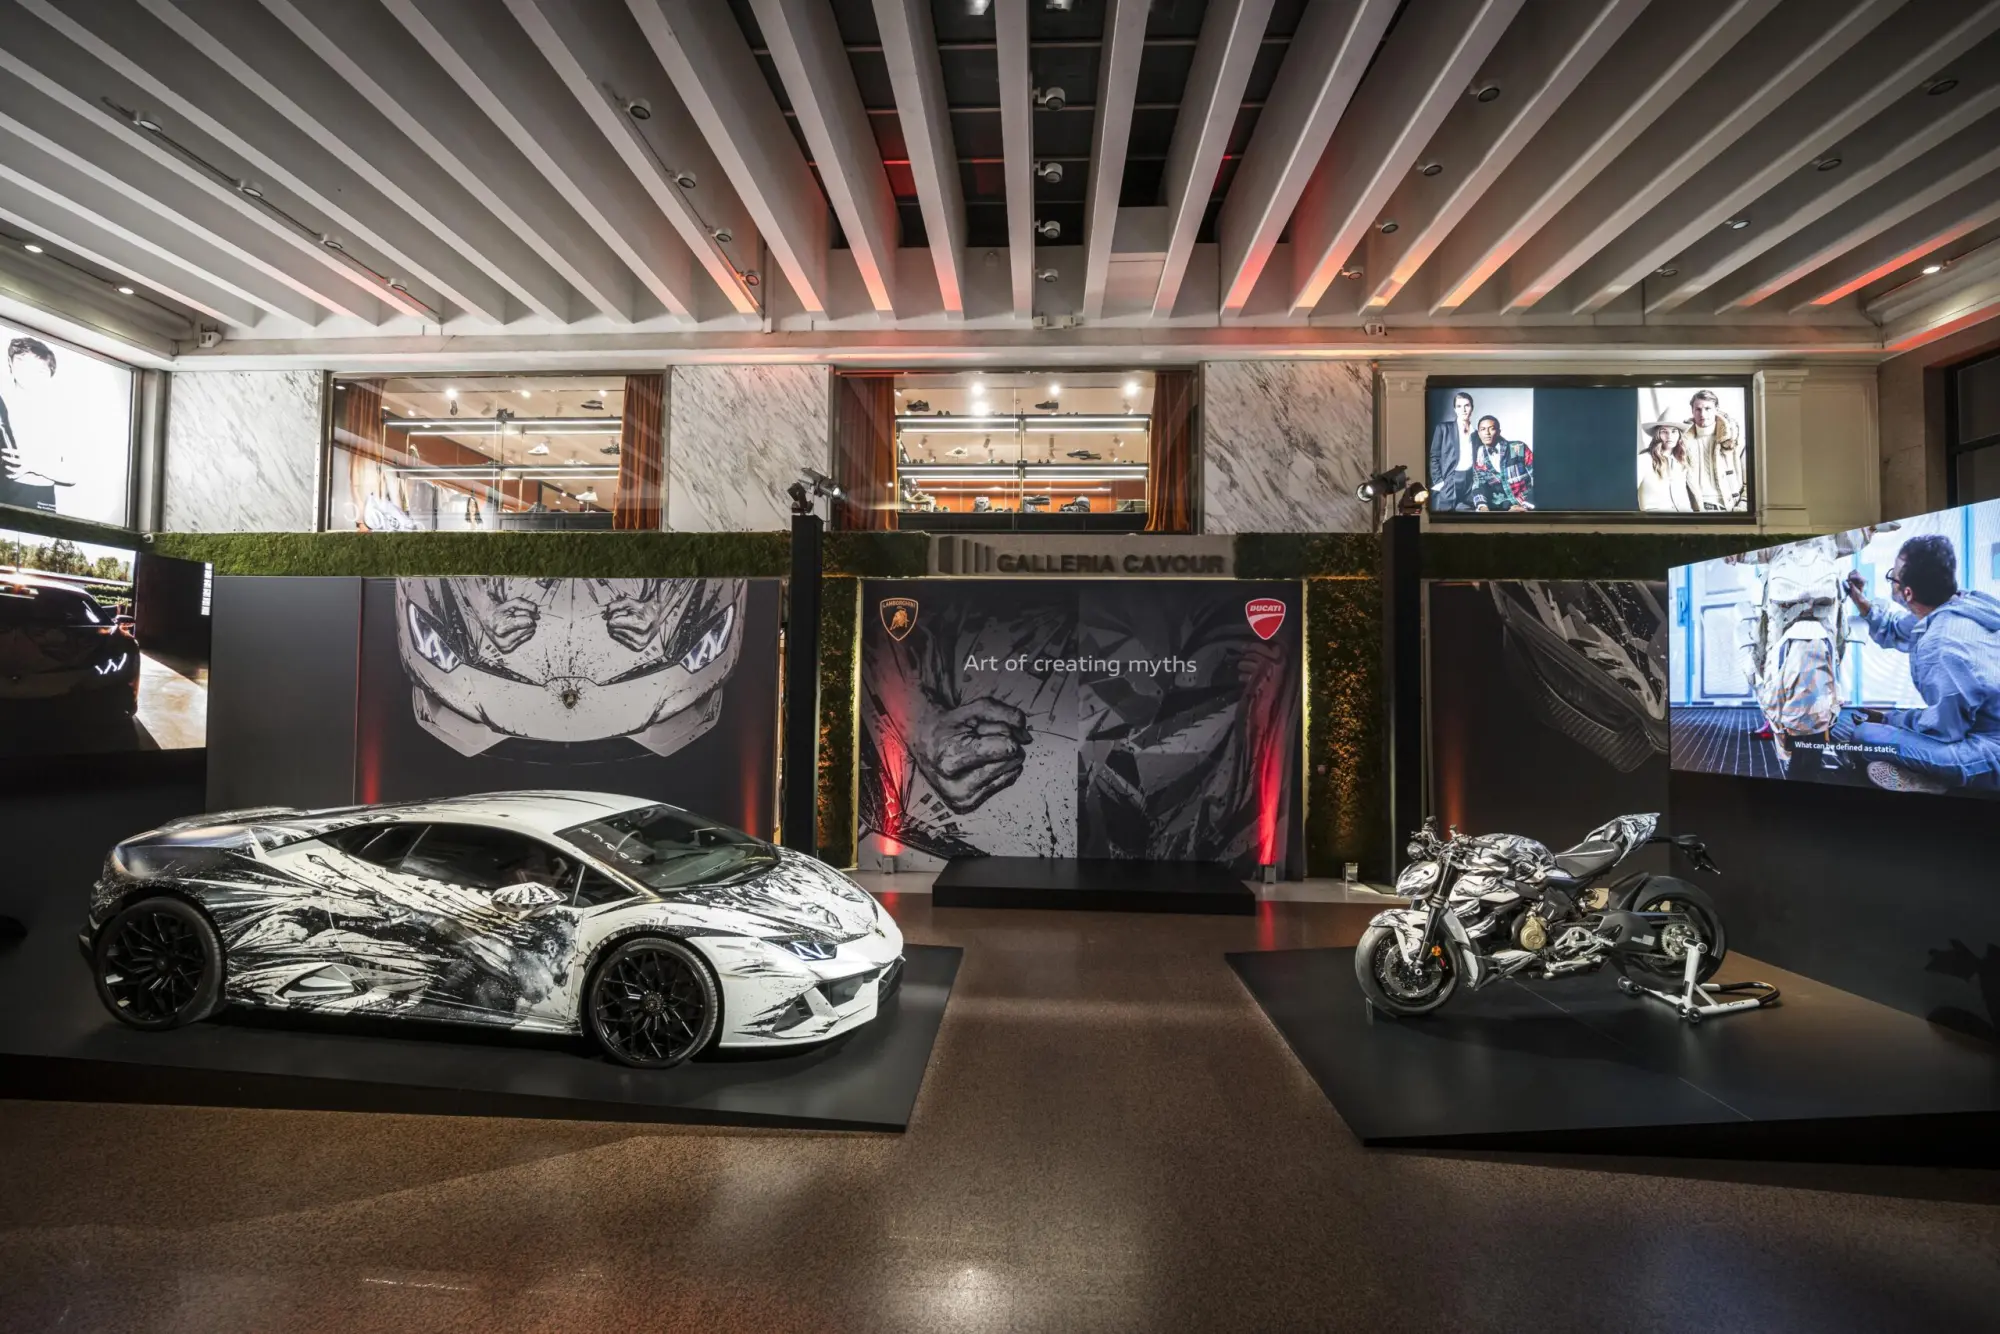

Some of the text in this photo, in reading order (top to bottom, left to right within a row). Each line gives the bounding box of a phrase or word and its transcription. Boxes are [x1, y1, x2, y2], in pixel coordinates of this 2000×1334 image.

[996, 554, 1225, 573] GALLERIA CAVOUR
[1250, 604, 1282, 612] DUCATI
[963, 654, 1198, 677] Art of creating myths
[1794, 741, 1812, 749] What
[1836, 743, 1863, 752] defined
[1874, 745, 1898, 754] static,
